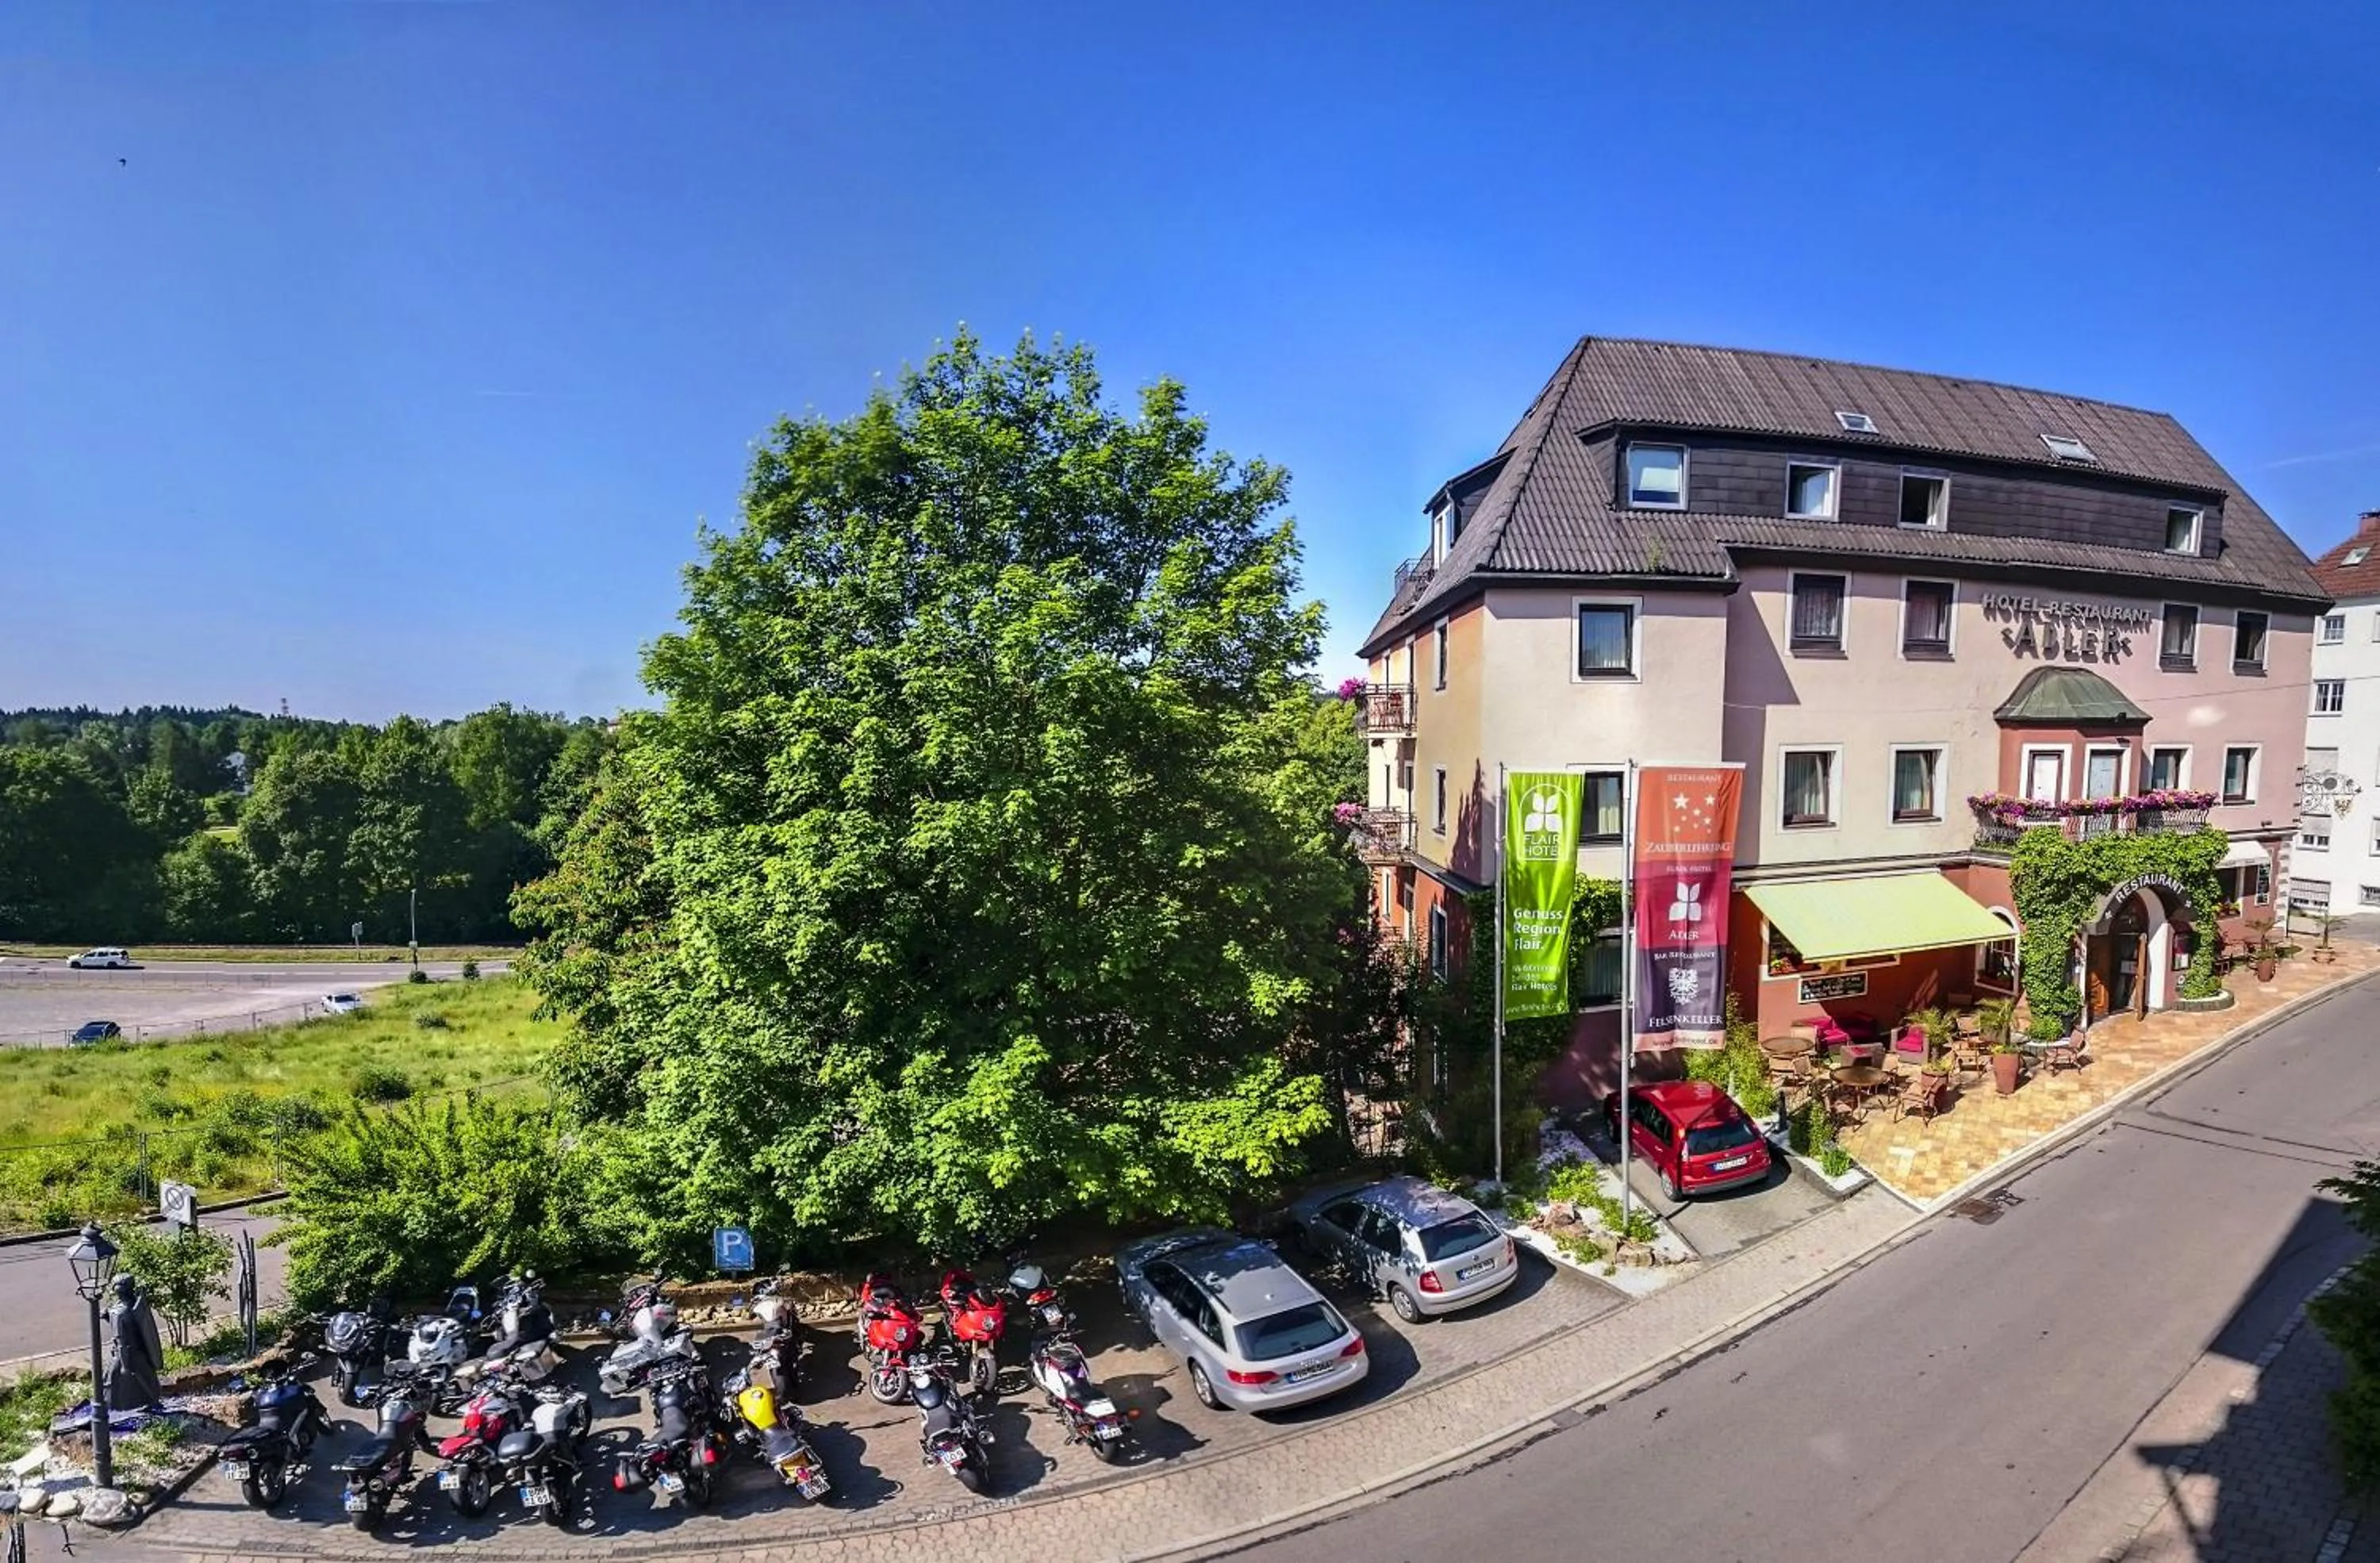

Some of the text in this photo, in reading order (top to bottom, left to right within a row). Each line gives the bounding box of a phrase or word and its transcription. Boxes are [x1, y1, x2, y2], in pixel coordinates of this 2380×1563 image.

[2013, 616, 2121, 655] ADLER
[2116, 874, 2185, 903] RESTAURANT
[1649, 1015, 1724, 1027] FELSENKELLER
[723, 1231, 743, 1256] P
